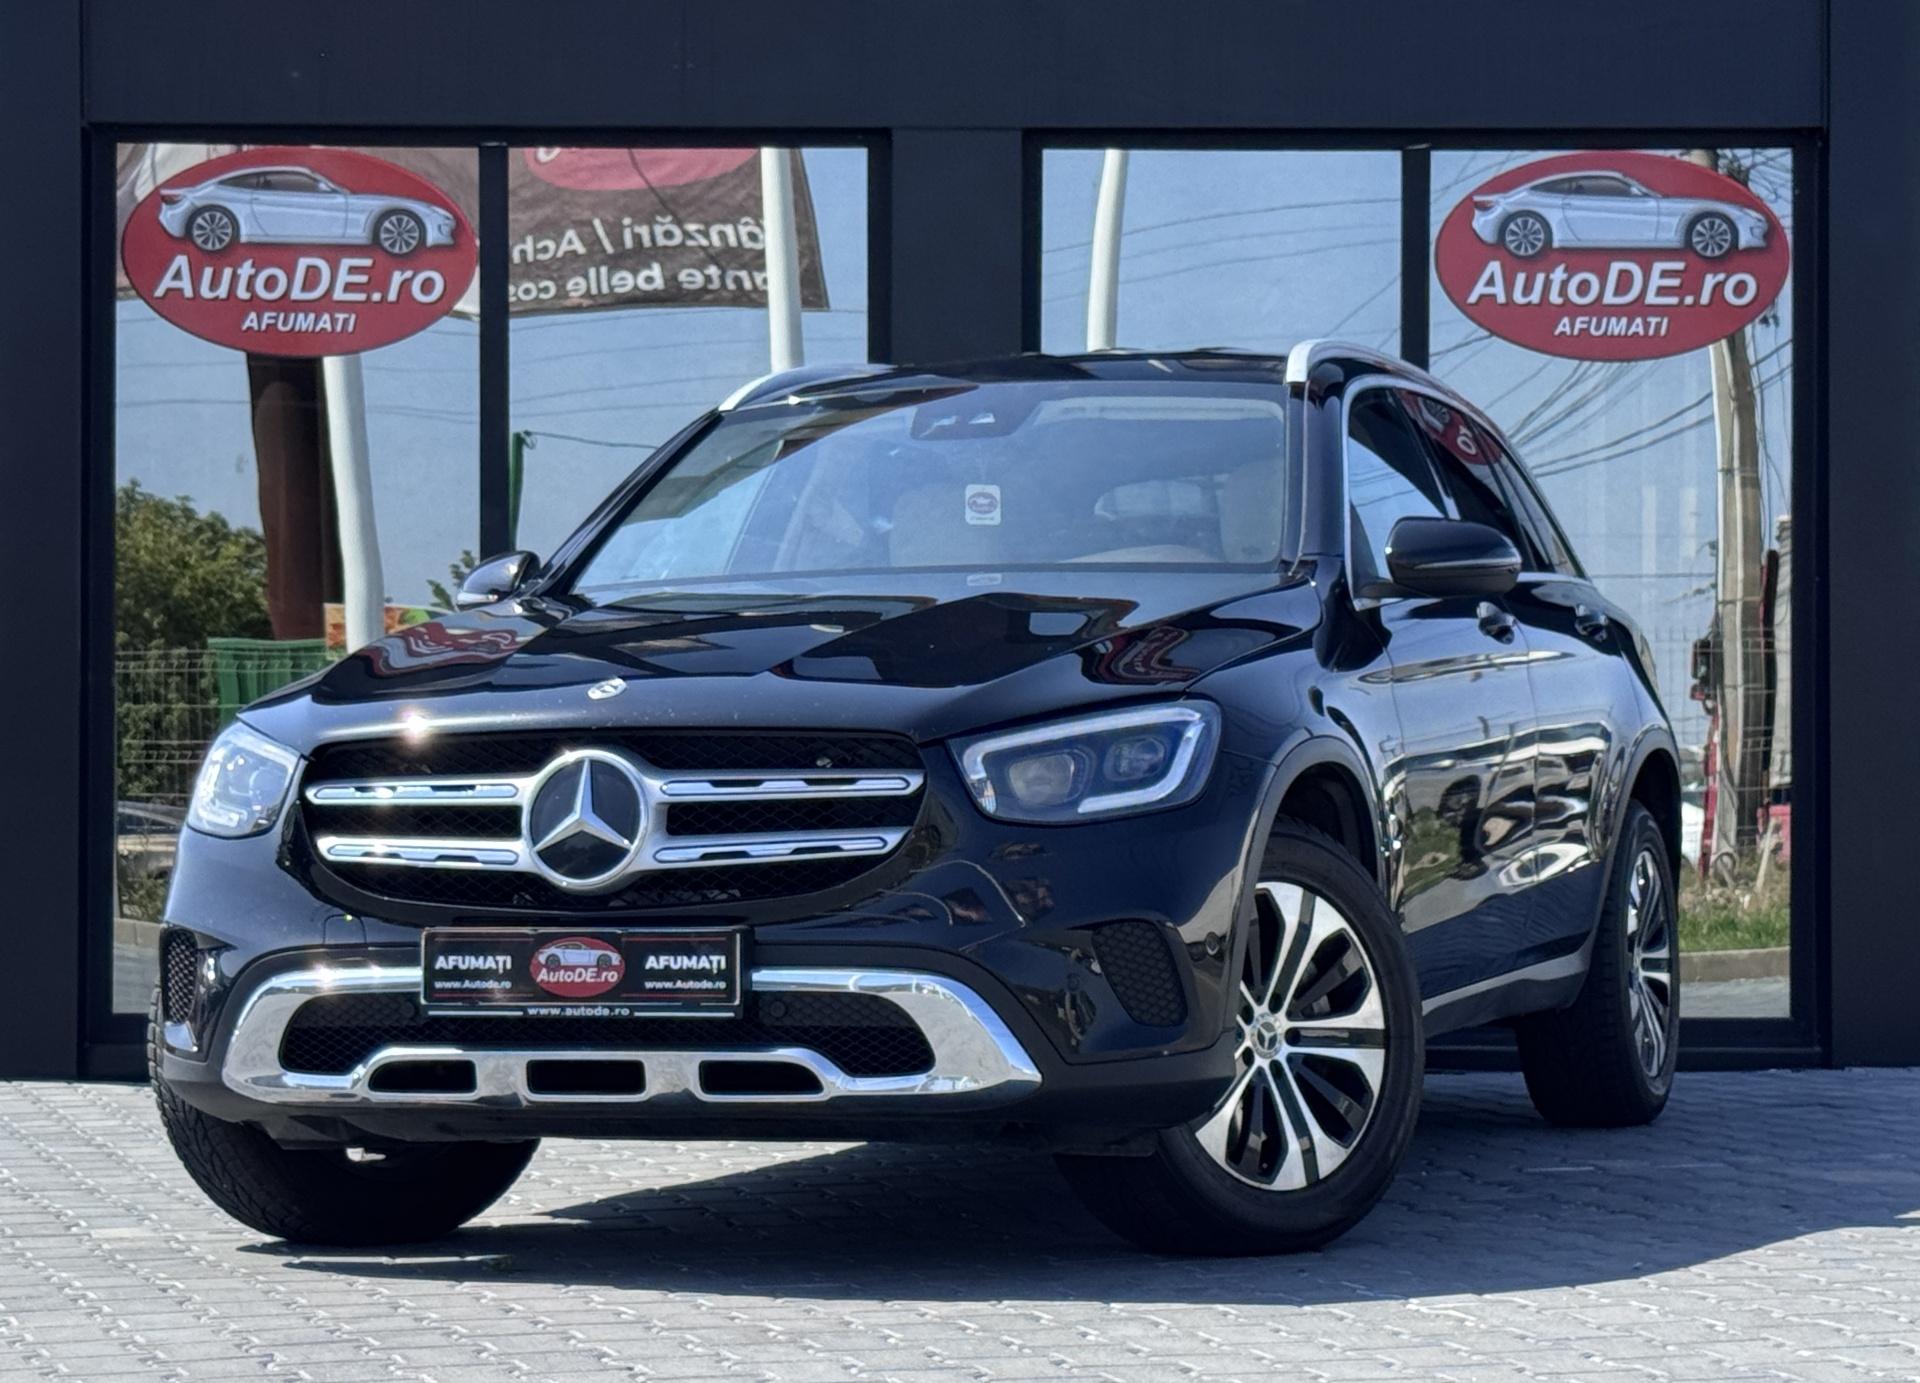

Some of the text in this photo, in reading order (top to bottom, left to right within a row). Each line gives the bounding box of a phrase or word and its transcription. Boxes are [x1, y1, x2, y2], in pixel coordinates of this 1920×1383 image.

[153, 255, 446, 303] AutoDE.ro
[1466, 260, 1758, 306] AutoDE.ro
[241, 311, 356, 333] AFUMATI
[1553, 316, 1669, 337] AFUMATI
[434, 979, 512, 989] www.Autode.ro
[536, 967, 618, 983] AutoDE.ro
[644, 979, 727, 989] www.Autode.ro
[527, 1006, 630, 1016] www.autode.ro
